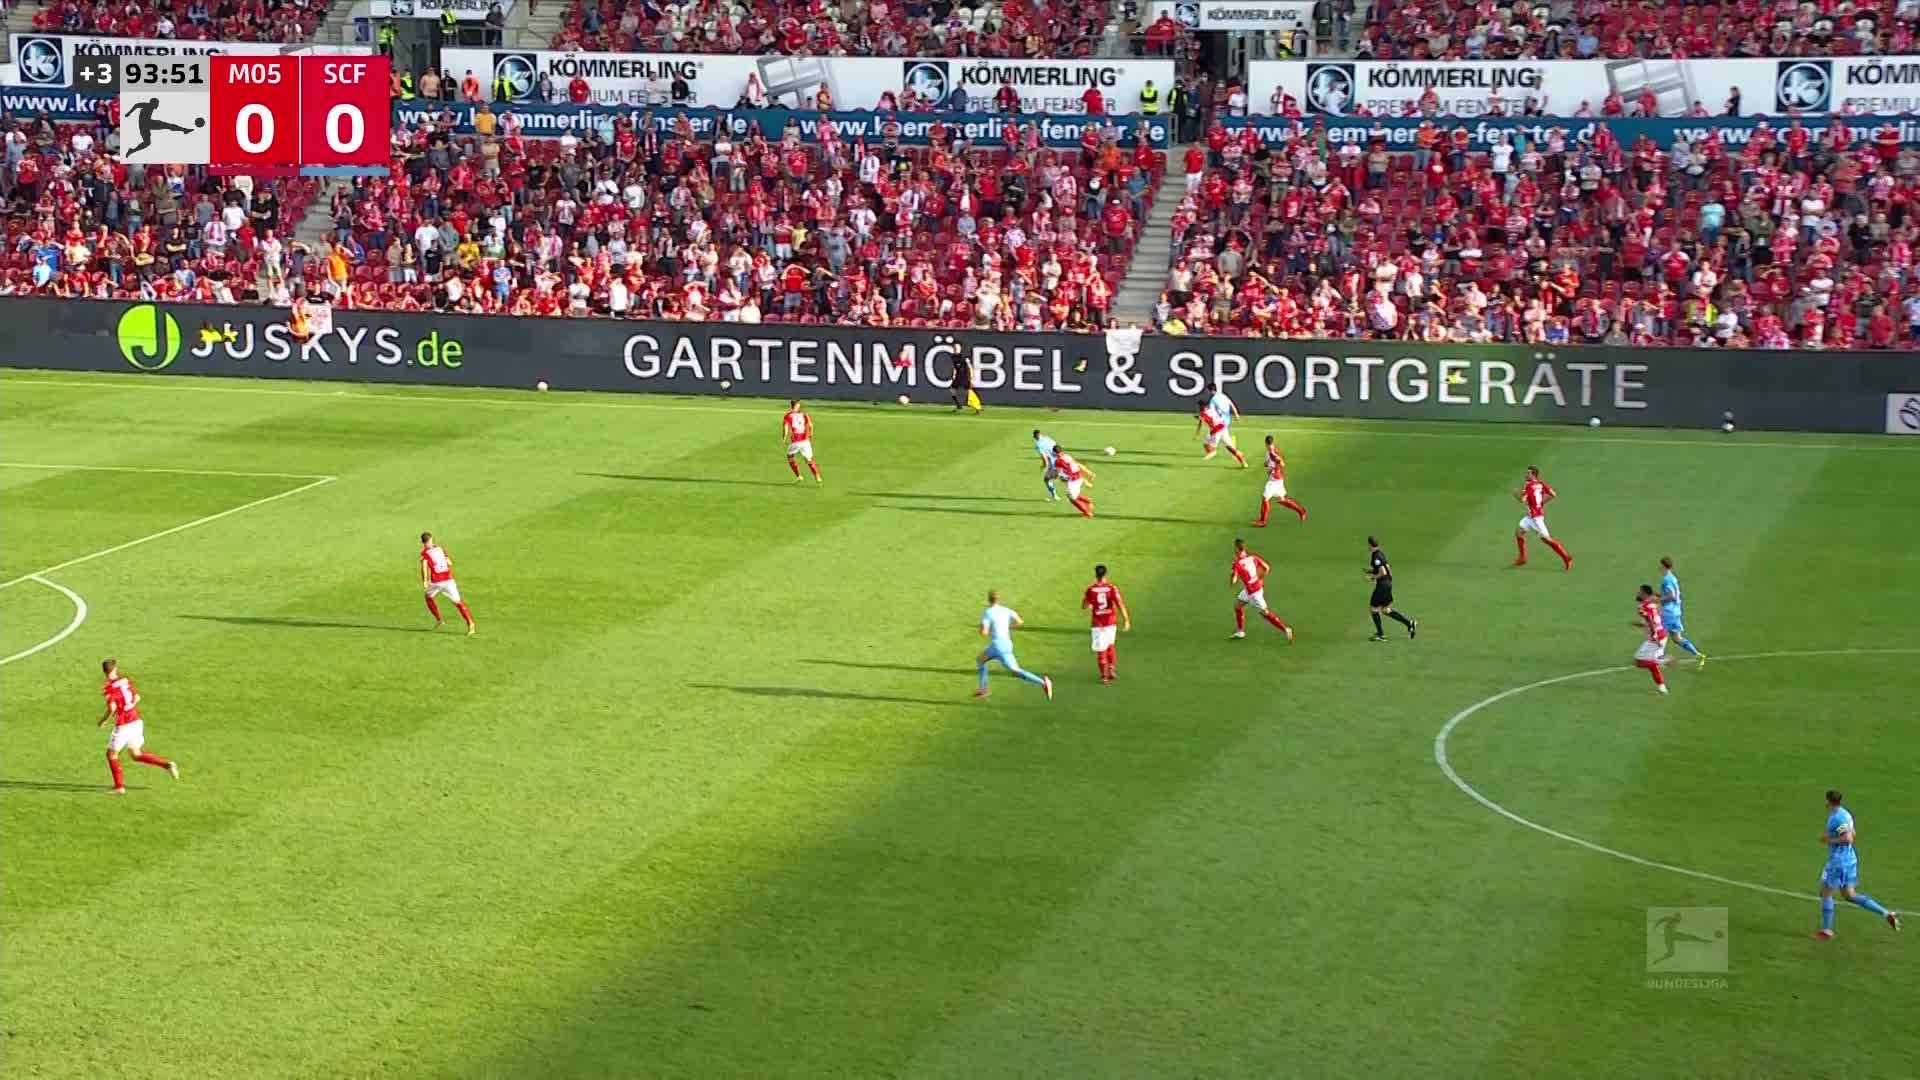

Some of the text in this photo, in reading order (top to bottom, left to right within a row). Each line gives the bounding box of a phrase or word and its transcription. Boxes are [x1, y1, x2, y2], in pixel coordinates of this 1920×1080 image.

[549, 53, 697, 80] KÖMMERLING
[961, 60, 1117, 86] KÖMMERLING
[1367, 63, 1536, 88] KÖMMERLING
[551, 88, 623, 102] PRIUM
[1043, 97, 1117, 112] FENSR
[191, 321, 464, 368] JUSKYS.de
[623, 334, 1649, 409] GARTENMÖBEL & SPORTGERÄTE
